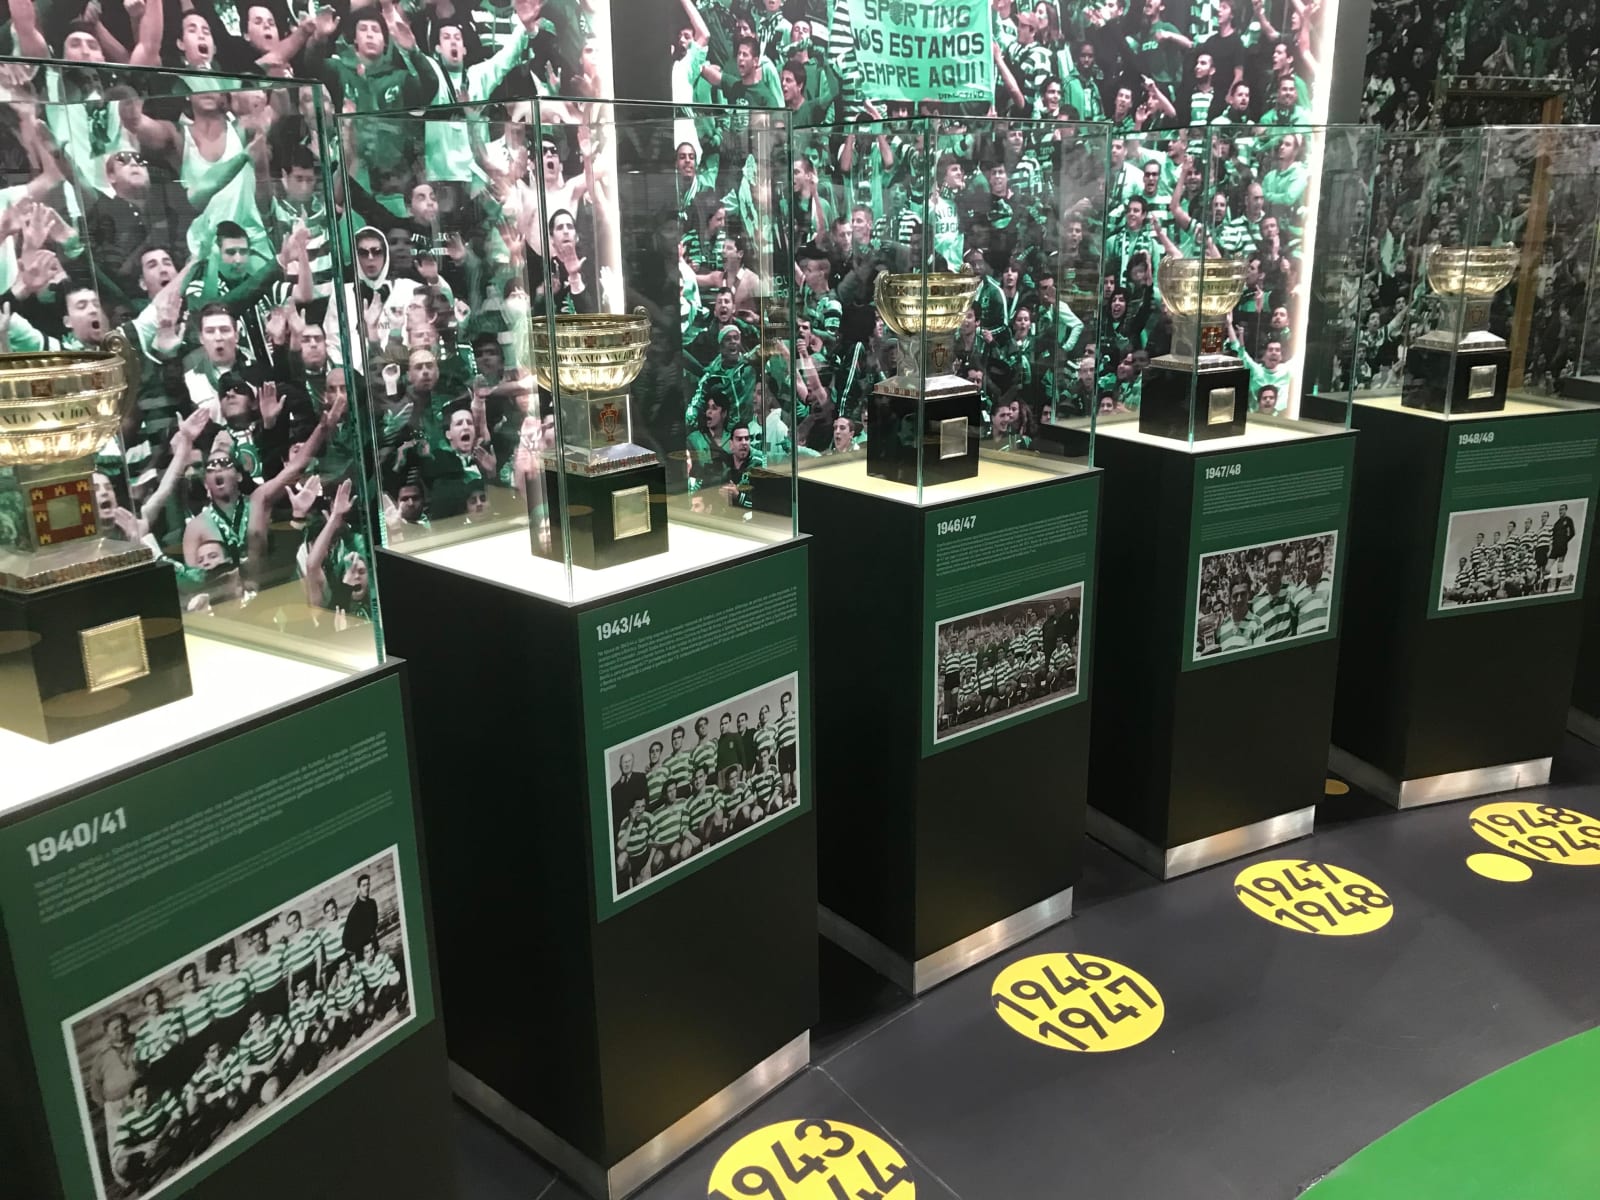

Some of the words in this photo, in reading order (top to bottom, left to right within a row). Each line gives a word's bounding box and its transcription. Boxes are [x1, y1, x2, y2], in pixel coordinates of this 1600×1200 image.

[864, 0, 971, 28] SPORTING
[889, 32, 985, 59] ESTAMOS
[857, 62, 920, 88] SEMPRE
[1205, 463, 1242, 480] 1947/48
[937, 515, 977, 536] 1946/47
[596, 610, 651, 641] 1943/44
[26, 807, 127, 867] 1940/41
[1470, 805, 1582, 838] 1948
[1235, 860, 1342, 907] 1947
[1275, 884, 1392, 933] 1948
[992, 953, 1111, 1021] 1946
[1039, 975, 1158, 1051] 1947
[827, 1150, 914, 1200] 44
